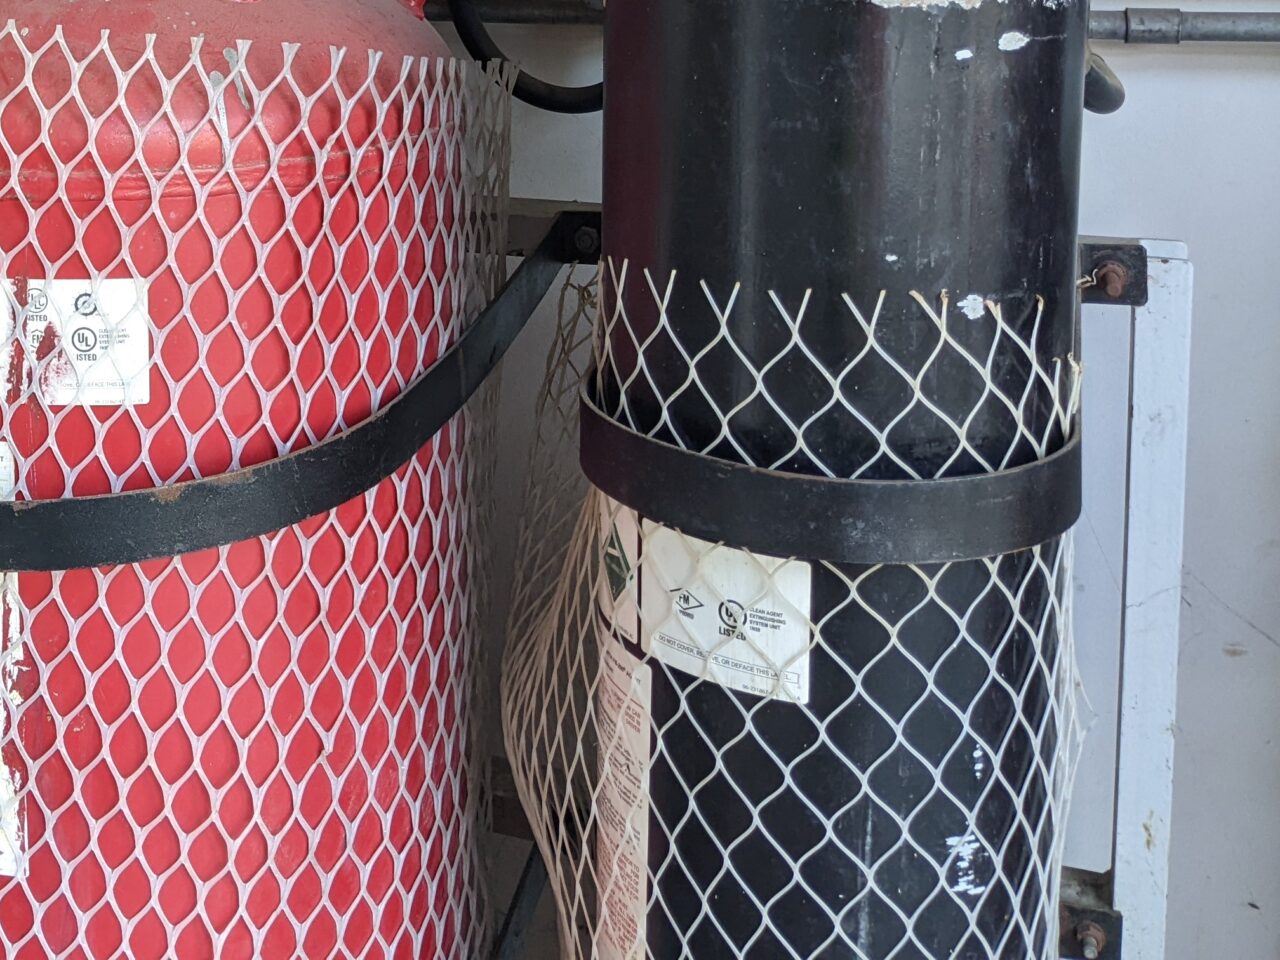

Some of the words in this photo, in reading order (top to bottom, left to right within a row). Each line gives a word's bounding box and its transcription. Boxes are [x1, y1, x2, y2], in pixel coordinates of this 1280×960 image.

[77, 332, 91, 347] UL
[766, 610, 784, 619] AGENT
[666, 638, 676, 646] NOT
[677, 642, 696, 655] COVER,
[721, 658, 730, 666] OR
[730, 660, 755, 673] DEFACE
[756, 667, 770, 676] THIS
